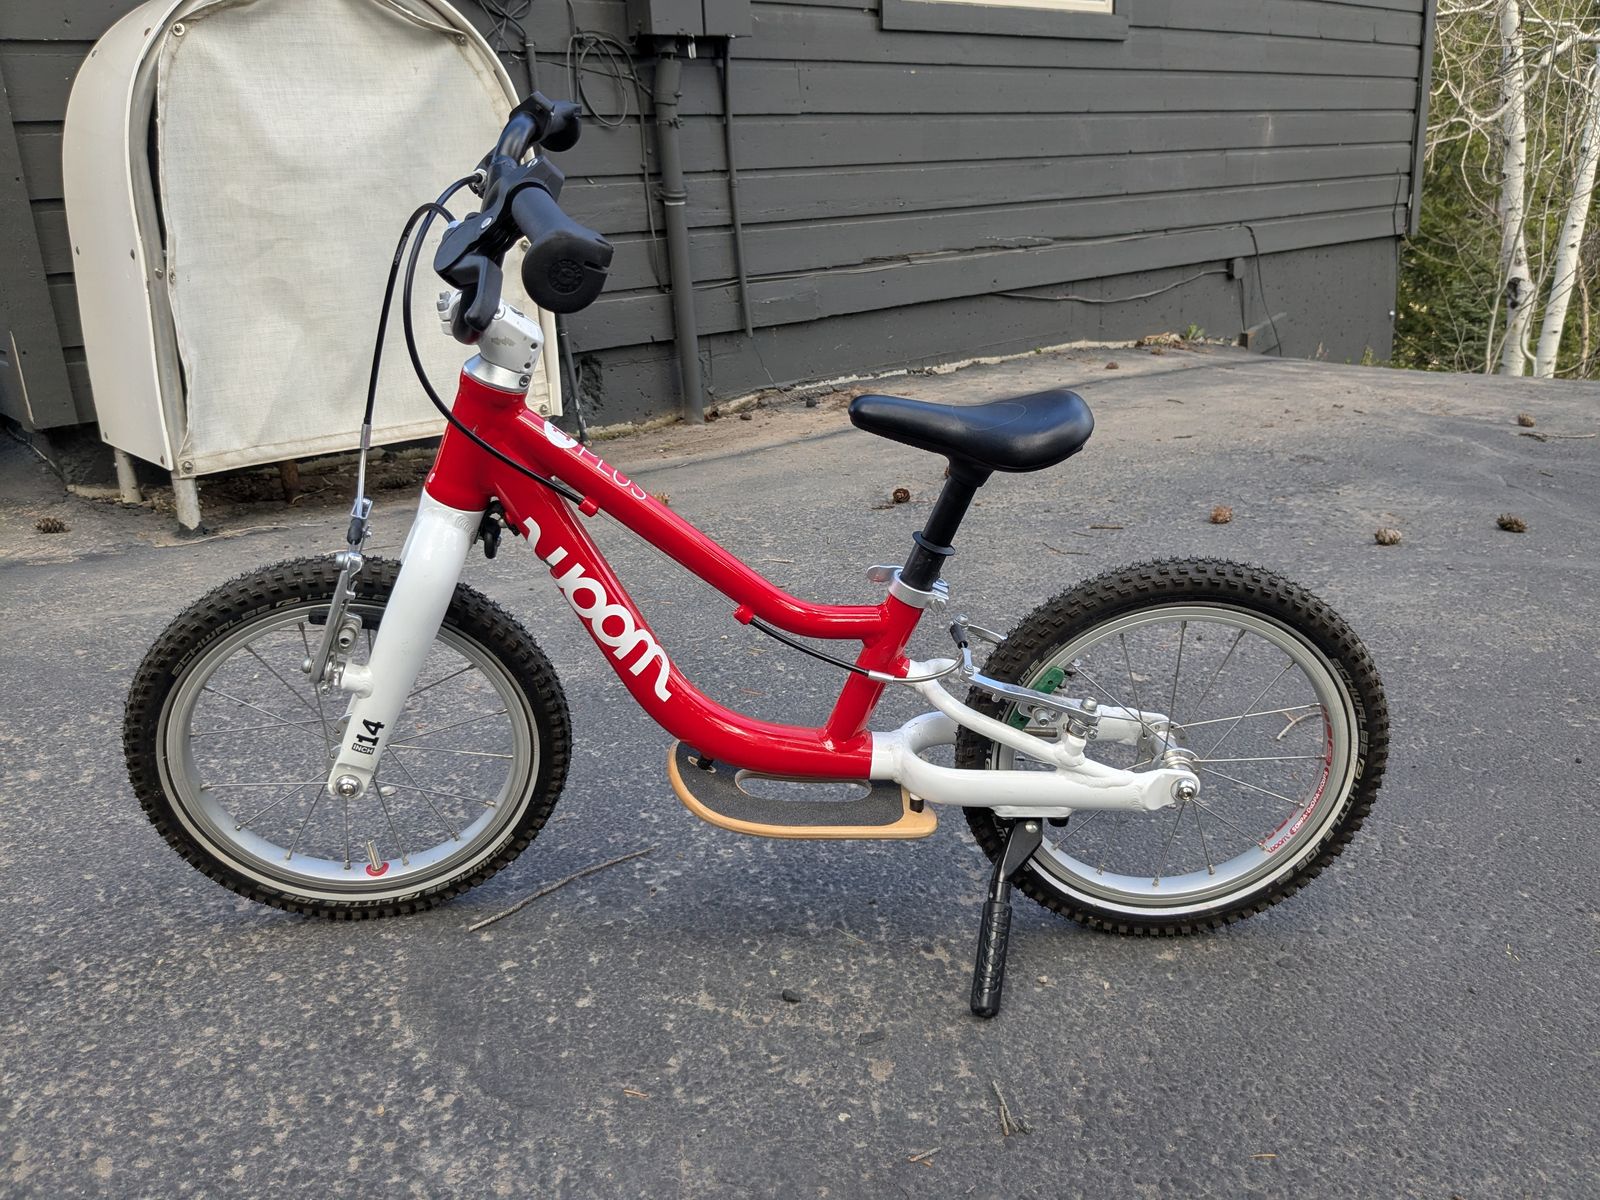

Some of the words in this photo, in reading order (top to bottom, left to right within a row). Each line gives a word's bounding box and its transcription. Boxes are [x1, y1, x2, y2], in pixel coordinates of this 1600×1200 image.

[523, 516, 672, 702] woom
[171, 604, 271, 677] SCHWALBE
[356, 719, 385, 746] 14
[1331, 657, 1369, 756] SCHWALBE
[352, 743, 375, 755] INCH
[1324, 781, 1360, 842] LITTLE
[425, 833, 515, 896] SCHWALBE
[1296, 842, 1325, 871] JOE
